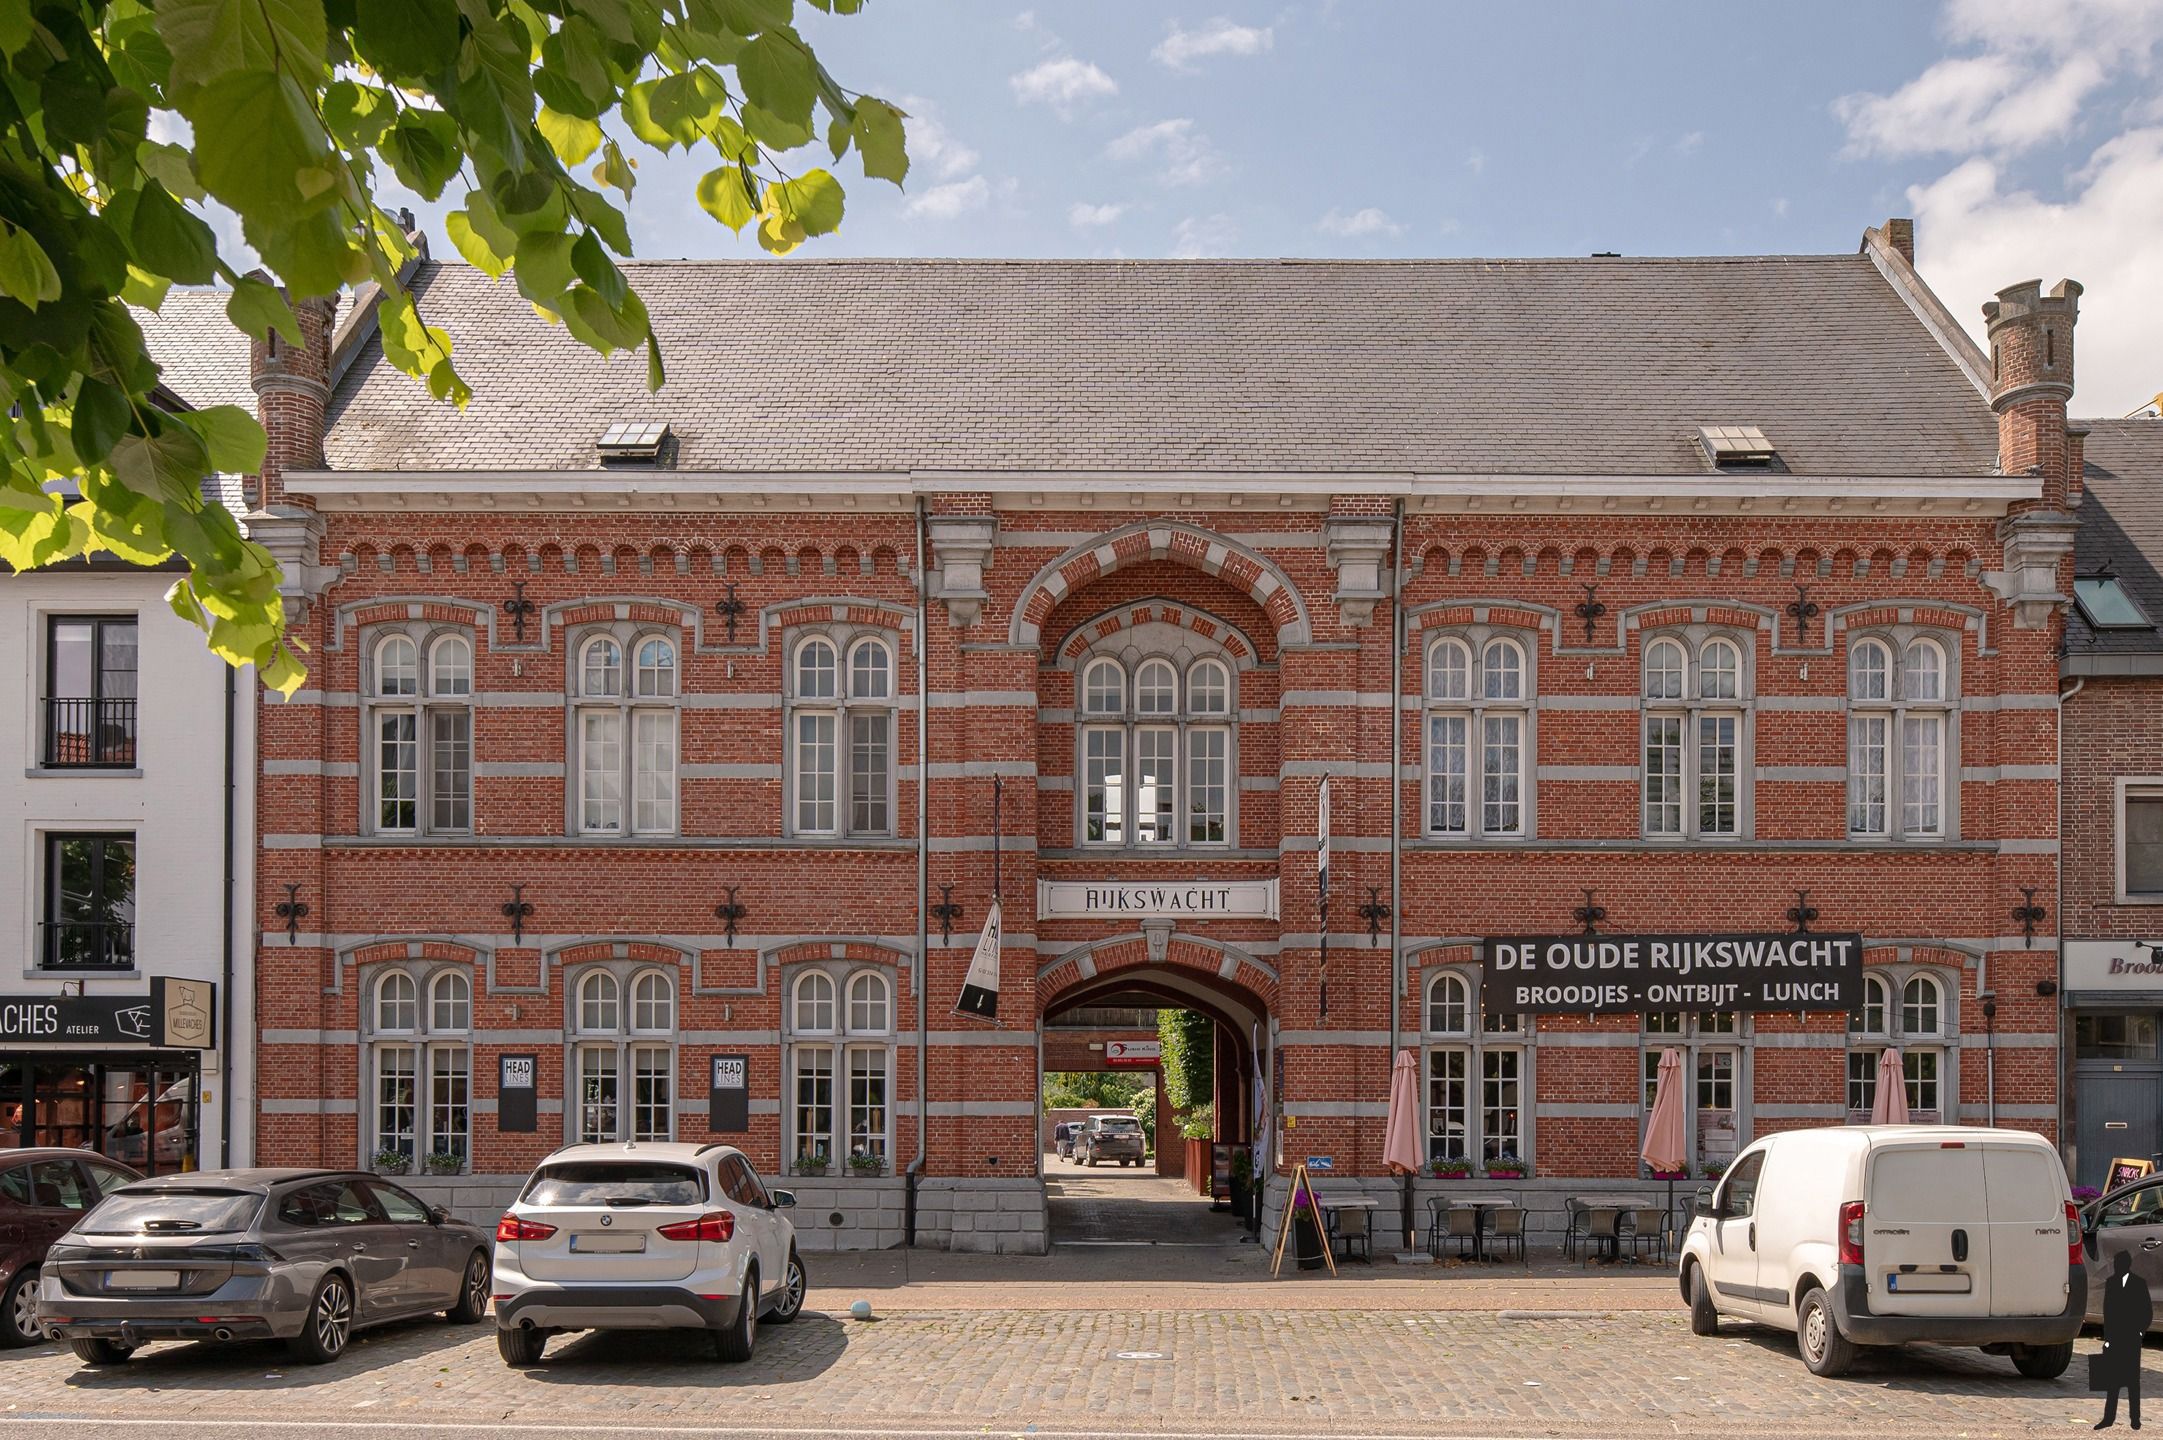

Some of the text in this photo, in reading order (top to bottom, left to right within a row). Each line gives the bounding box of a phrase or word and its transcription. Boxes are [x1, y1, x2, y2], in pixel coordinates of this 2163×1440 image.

[1086, 890, 1230, 909] RIJKSWACHT
[1495, 940, 1853, 975] DE OUDE RIJKSWACHT
[1516, 985, 1629, 1008] BROODJES
[1647, 983, 1739, 1007] ONTBIJT
[1762, 982, 1840, 1002] LUNCH
[0, 1004, 99, 1034] CHES ATELIER
[505, 1061, 531, 1074] HEAD
[717, 1062, 742, 1075] HEAD
[505, 1074, 530, 1083] LINES
[716, 1075, 741, 1084] LINES
[2118, 1166, 2140, 1180] SNACKS
